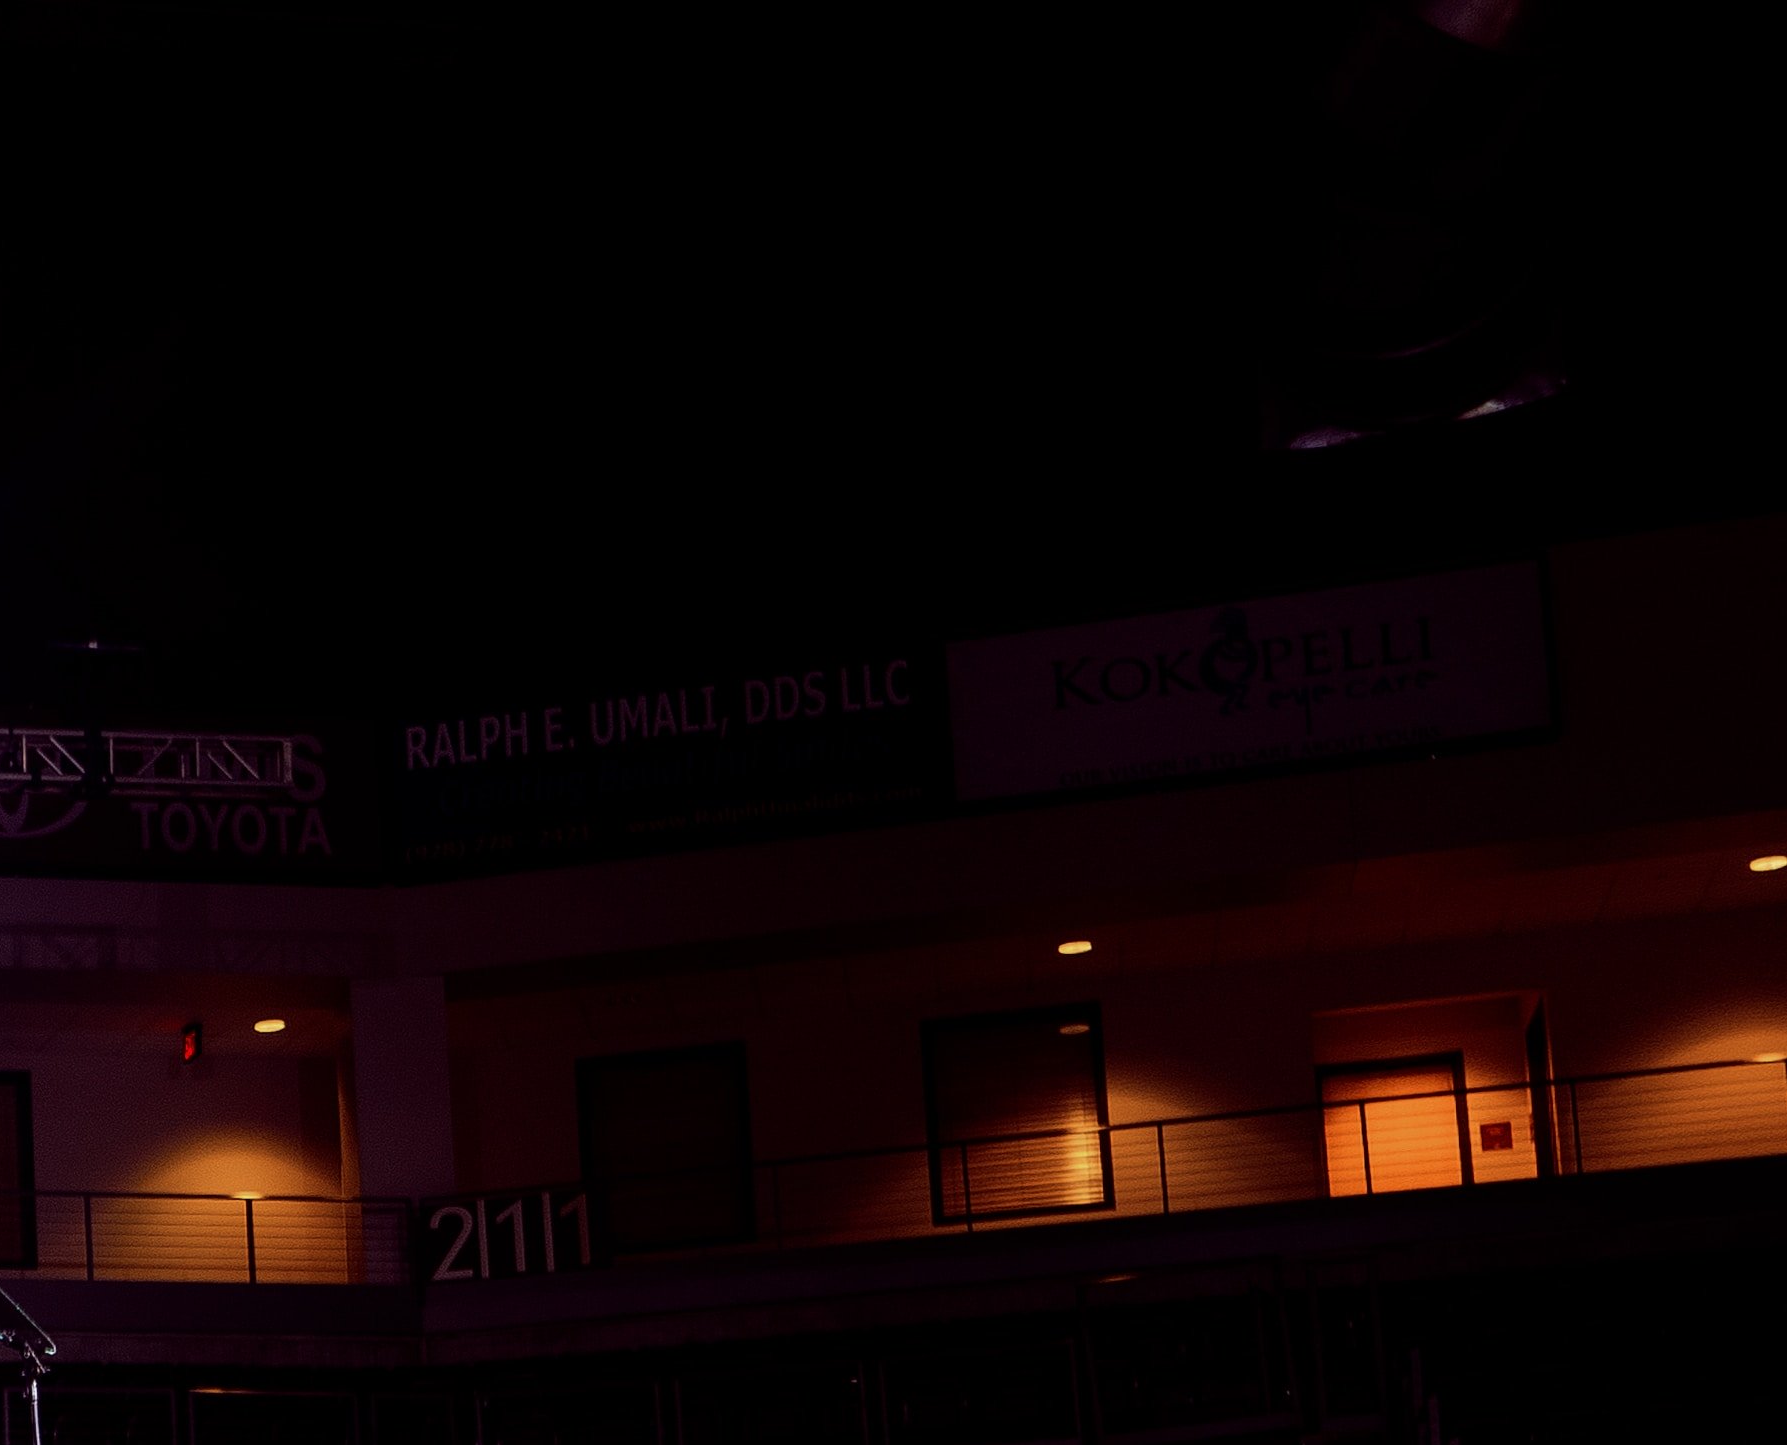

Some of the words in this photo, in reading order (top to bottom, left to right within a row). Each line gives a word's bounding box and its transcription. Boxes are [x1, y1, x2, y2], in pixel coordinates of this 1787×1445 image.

[404, 710, 530, 772] RALPH
[543, 706, 576, 754] E.
[589, 684, 732, 748] UMALI,
[744, 670, 828, 725] DDS
[839, 658, 913, 713] LLC
[129, 801, 333, 856] TOYOTA
